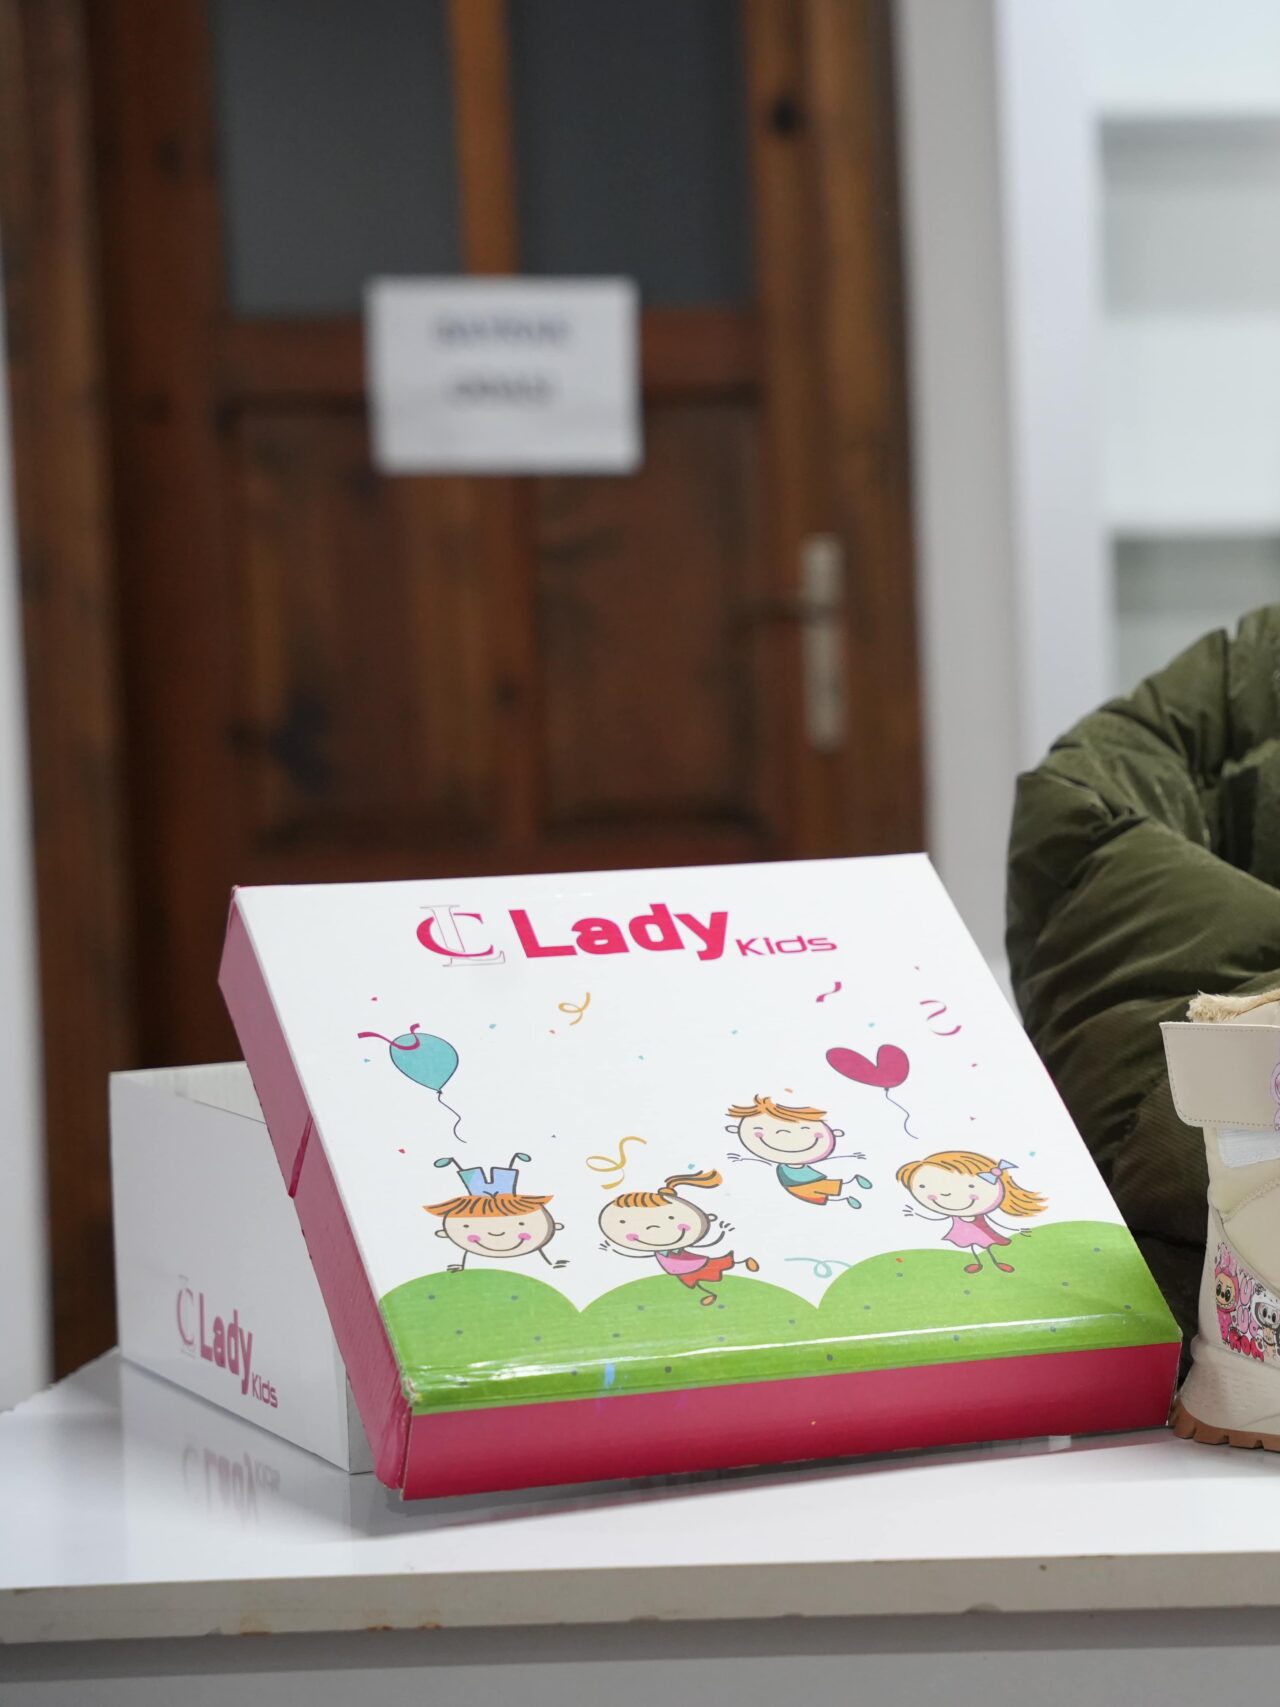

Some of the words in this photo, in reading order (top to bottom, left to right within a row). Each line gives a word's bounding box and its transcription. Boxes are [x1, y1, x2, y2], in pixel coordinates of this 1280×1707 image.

[508, 903, 729, 961] Lady
[735, 935, 838, 956] Kids
[199, 1291, 253, 1396] Lady
